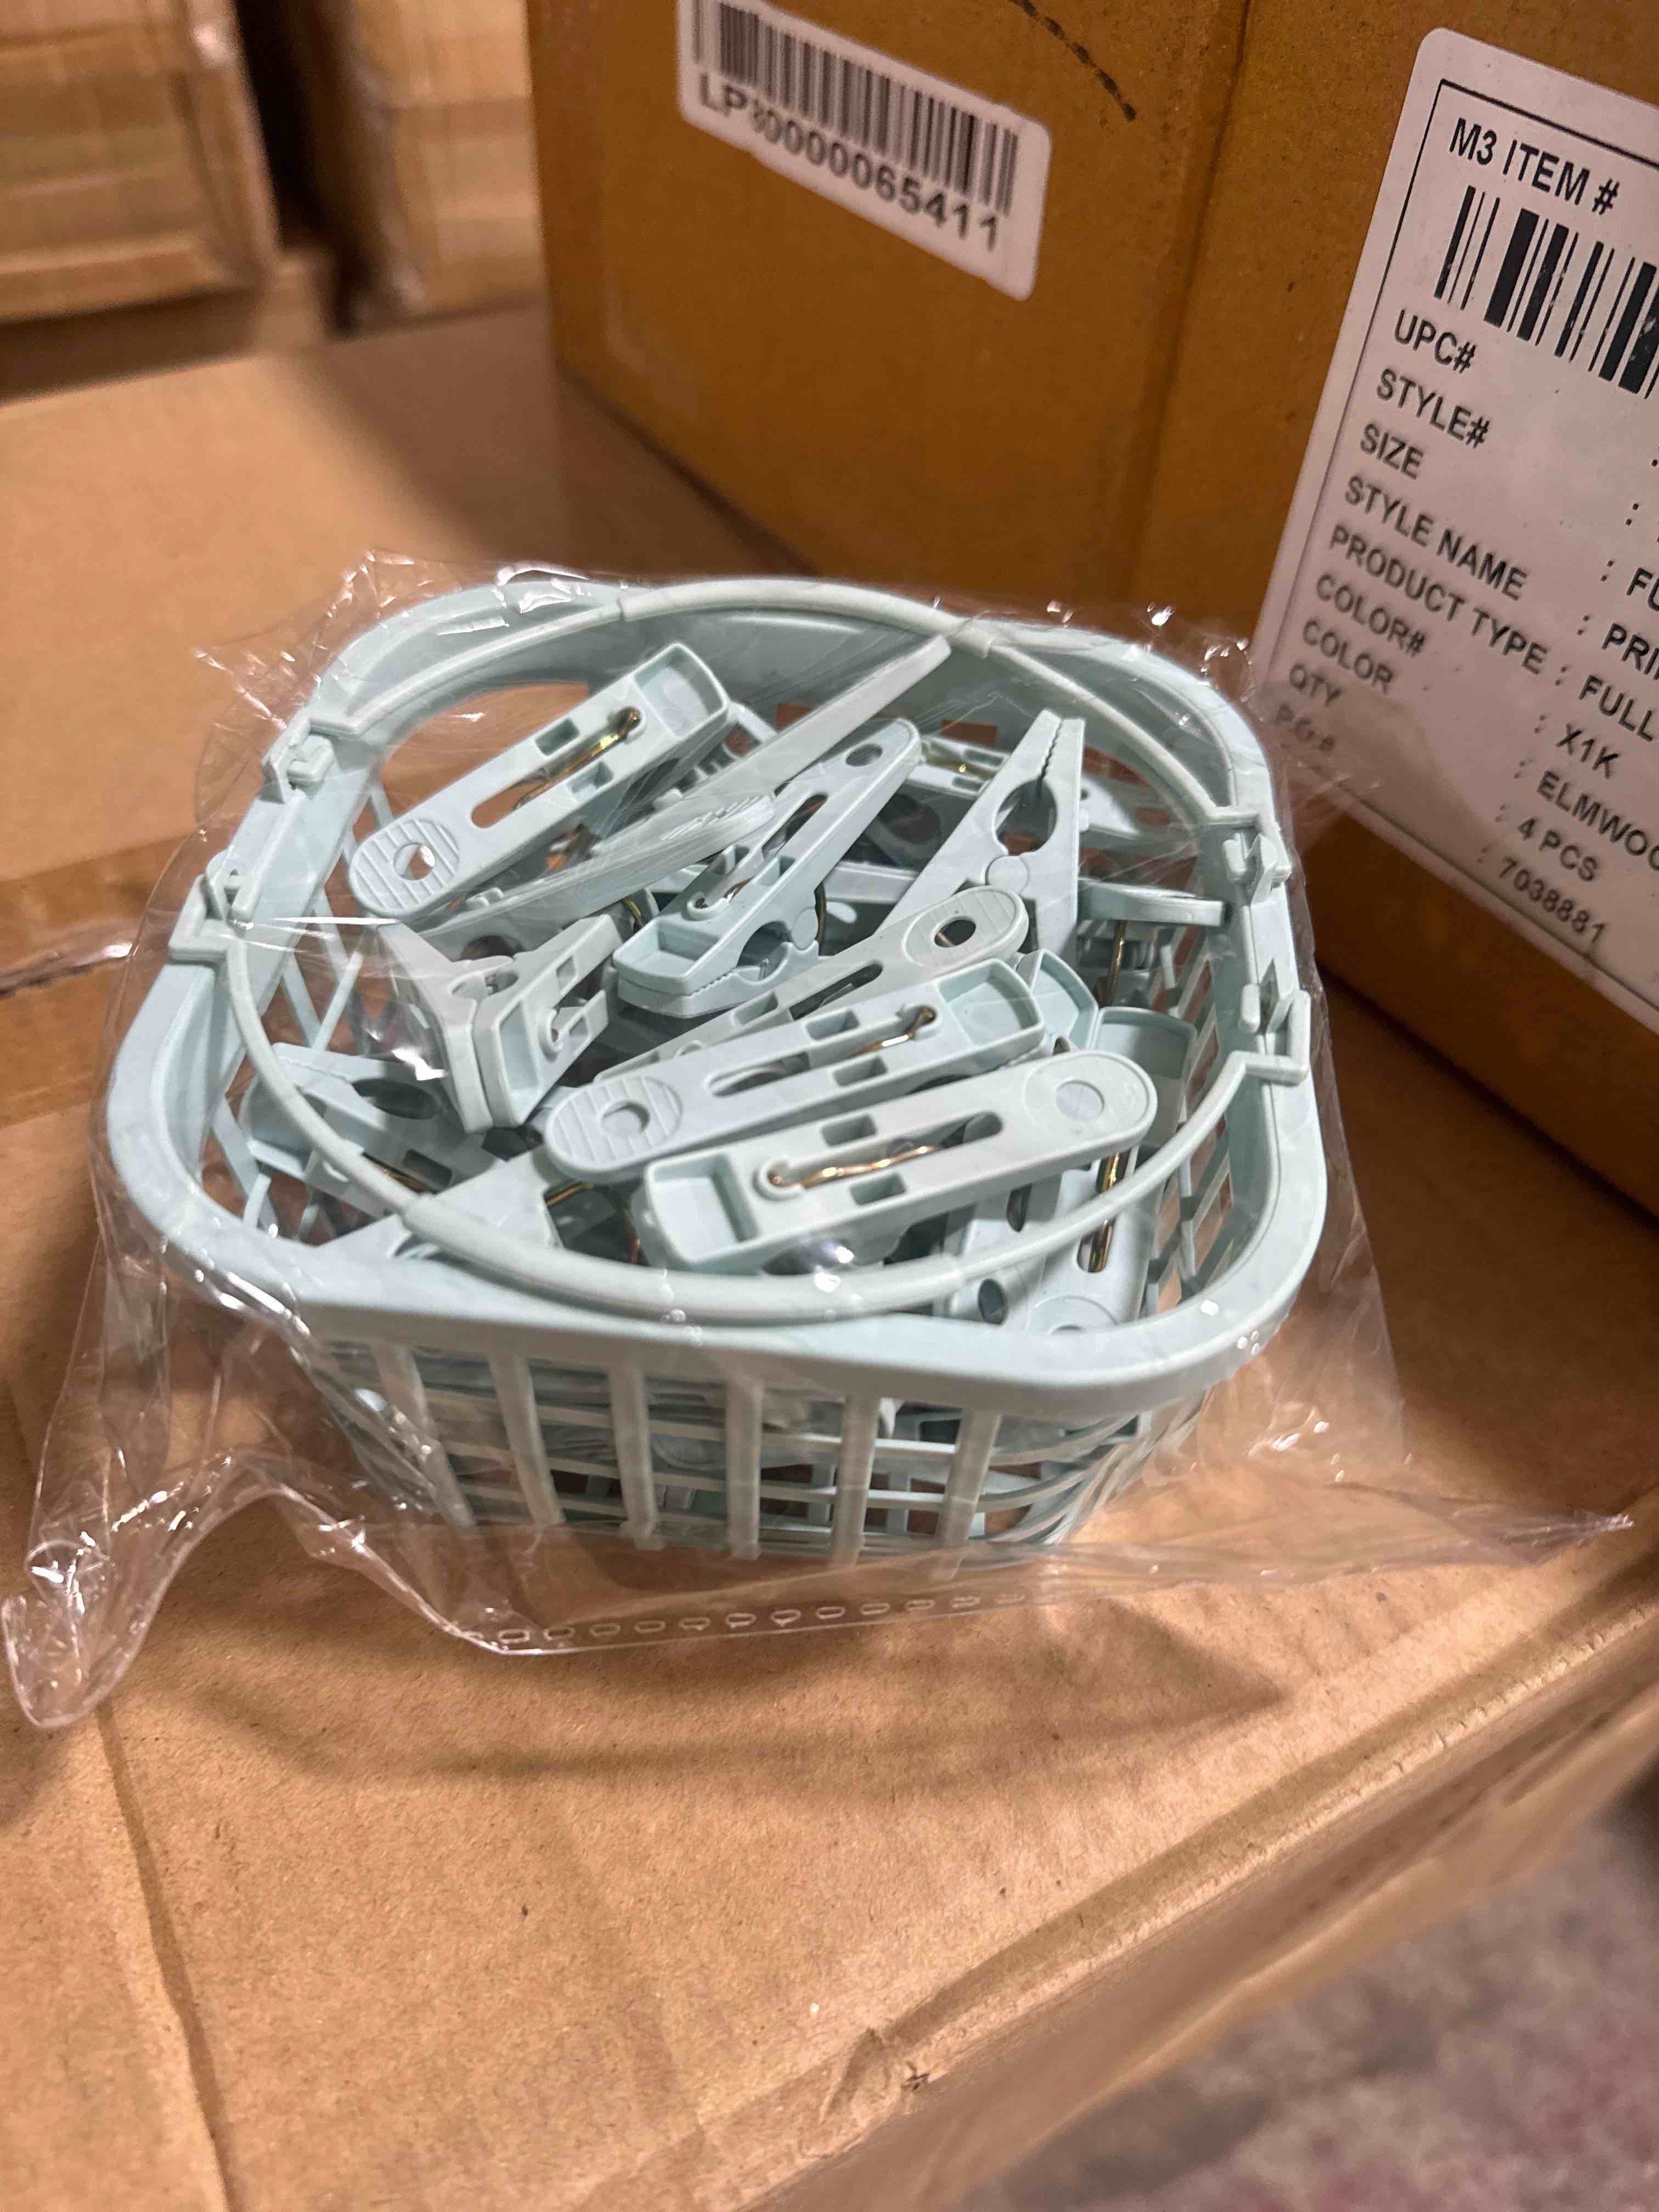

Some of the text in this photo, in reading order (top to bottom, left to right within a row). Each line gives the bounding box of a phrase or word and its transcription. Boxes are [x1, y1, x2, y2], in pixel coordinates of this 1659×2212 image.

[1448, 117, 1620, 216] M3 ITEM #
[1393, 308, 1477, 375] UPC#
[1359, 422, 1424, 481] SIZE
[1376, 368, 1491, 449] STYLE#
[1344, 476, 1435, 548] STYLE
[1437, 528, 1529, 601] NAME
[1302, 619, 1396, 695] COLOR
[1316, 573, 1427, 658] COLOR#
[1556, 723, 1621, 780] X1K
[1330, 523, 1466, 623] PRODUCT
[1471, 607, 1548, 675] TYPE
[1579, 674, 1655, 742] FULL
[1289, 663, 1342, 707] QTY
[1517, 817, 1537, 841] 4
[1539, 830, 1598, 882] PCS
[1499, 856, 1606, 944] 7038881
